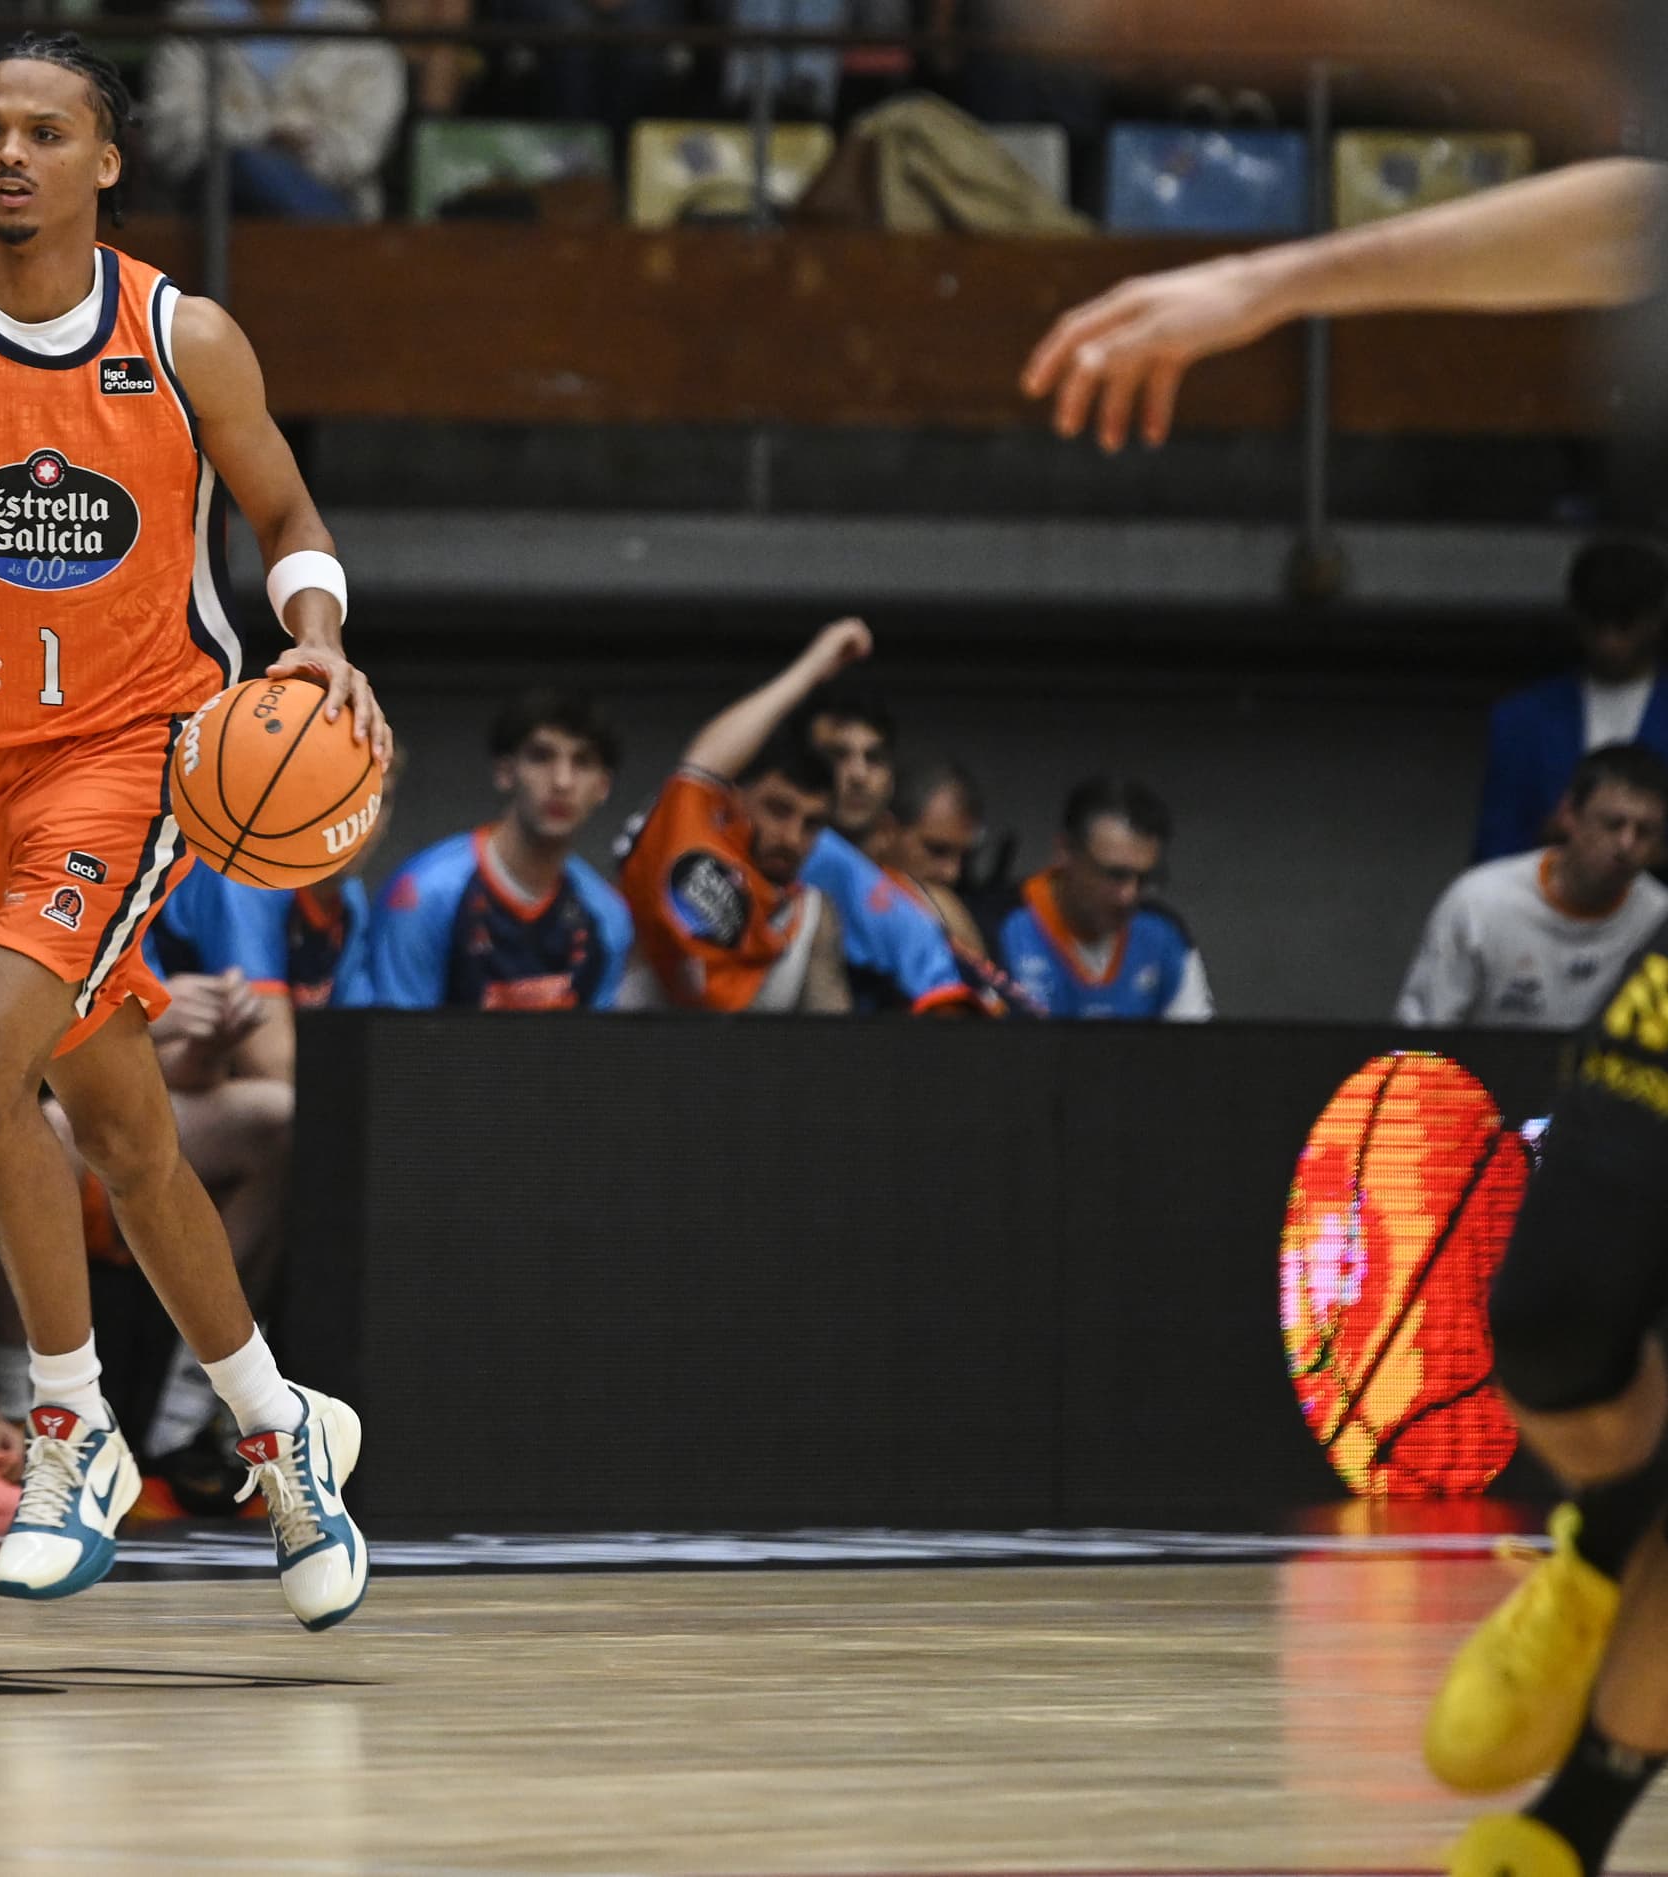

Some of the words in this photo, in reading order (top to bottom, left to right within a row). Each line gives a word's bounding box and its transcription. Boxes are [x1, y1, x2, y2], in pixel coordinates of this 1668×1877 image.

[104, 368, 126, 381] liga
[104, 379, 152, 391] endesa
[26, 555, 66, 584] 0,0
[38, 626, 64, 706] 1
[253, 684, 287, 719] acb
[70, 860, 97, 879] acb
